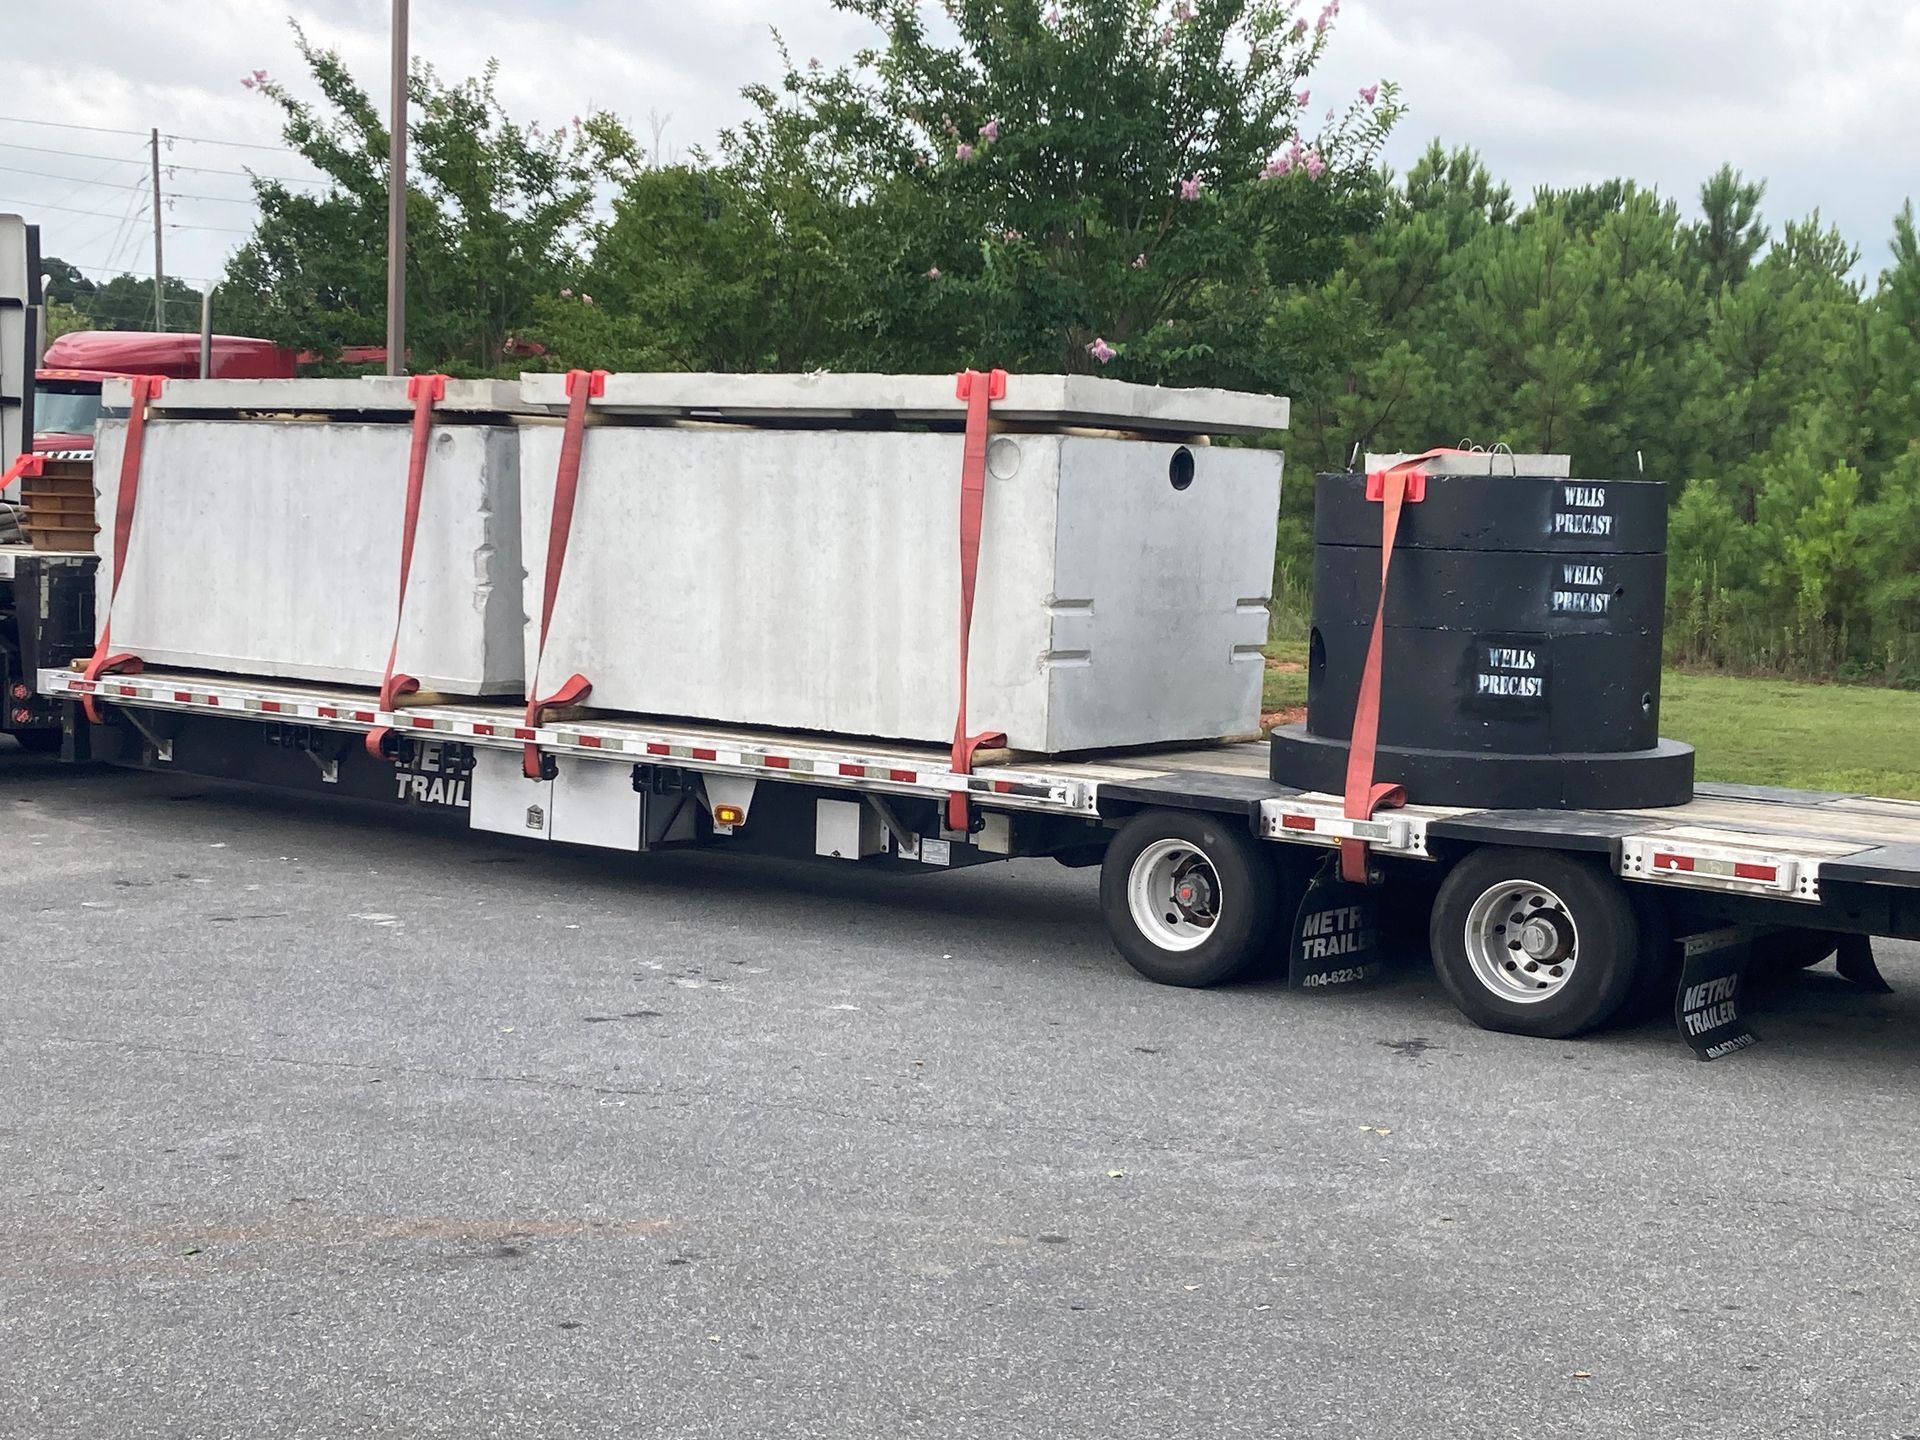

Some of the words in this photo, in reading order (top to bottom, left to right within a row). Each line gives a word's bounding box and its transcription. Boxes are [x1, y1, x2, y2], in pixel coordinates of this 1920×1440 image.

[1564, 486, 1606, 507] WELLS
[1554, 513, 1613, 535] PRECAST
[1563, 564, 1605, 586] WELLS
[1552, 591, 1611, 613] PRECAST
[1488, 648, 1536, 670] WELLS
[1477, 674, 1542, 697] PRECAST
[1302, 905, 1363, 938] METR
[1302, 966, 1369, 987] 404-622-3
[1683, 973, 1738, 1012] METRO
[1684, 1000, 1738, 1037] TRAILER
